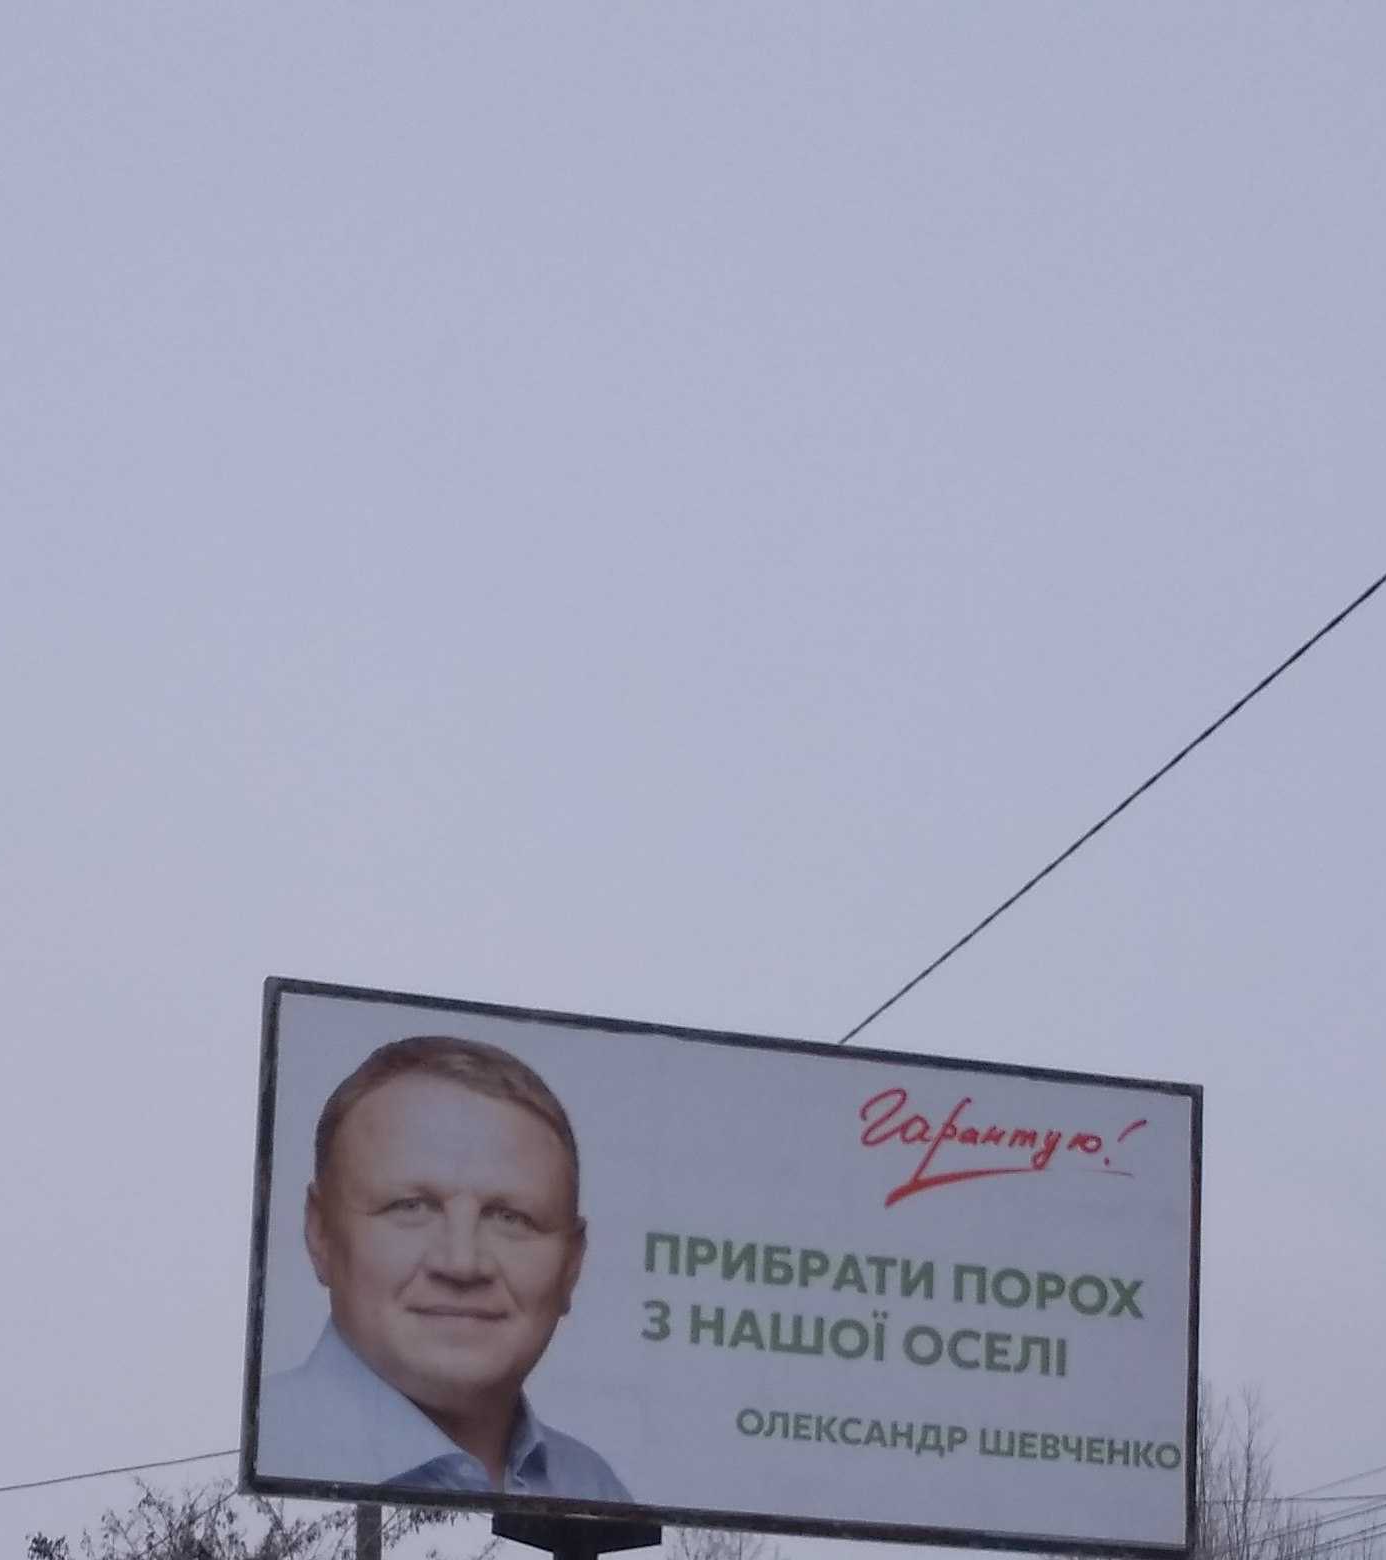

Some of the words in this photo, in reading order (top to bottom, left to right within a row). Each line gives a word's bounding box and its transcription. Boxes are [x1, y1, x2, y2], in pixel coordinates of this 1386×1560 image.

[644, 1231, 935, 1301] ПРИБРАТИ
[953, 1263, 1145, 1320] ПОРОХ
[640, 1300, 672, 1341] З
[688, 1306, 886, 1363] НАШОЇ
[902, 1324, 1068, 1378] ОСЕЛІ
[736, 1408, 968, 1456] ОЛЕКСАНДР
[979, 1426, 1182, 1471] ШЕВЧЕНКО
